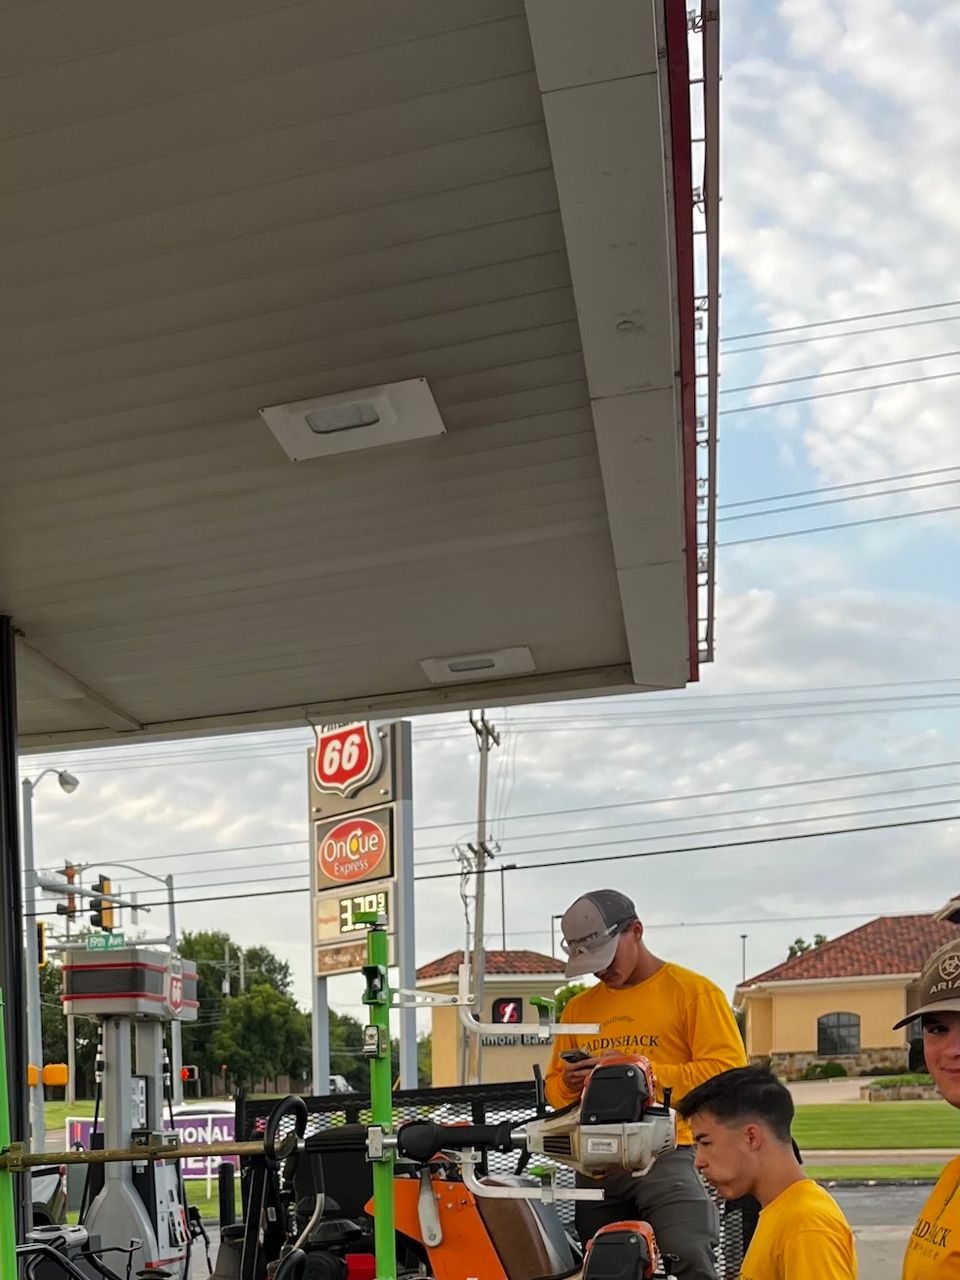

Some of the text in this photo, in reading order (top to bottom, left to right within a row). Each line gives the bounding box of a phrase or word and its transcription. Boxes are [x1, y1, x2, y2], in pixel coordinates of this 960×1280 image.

[322, 733, 362, 776] 66
[323, 828, 379, 862] OnCue
[334, 858, 369, 876] Express
[929, 980, 960, 995] ARIA
[178, 1126, 234, 1144] IONAL
